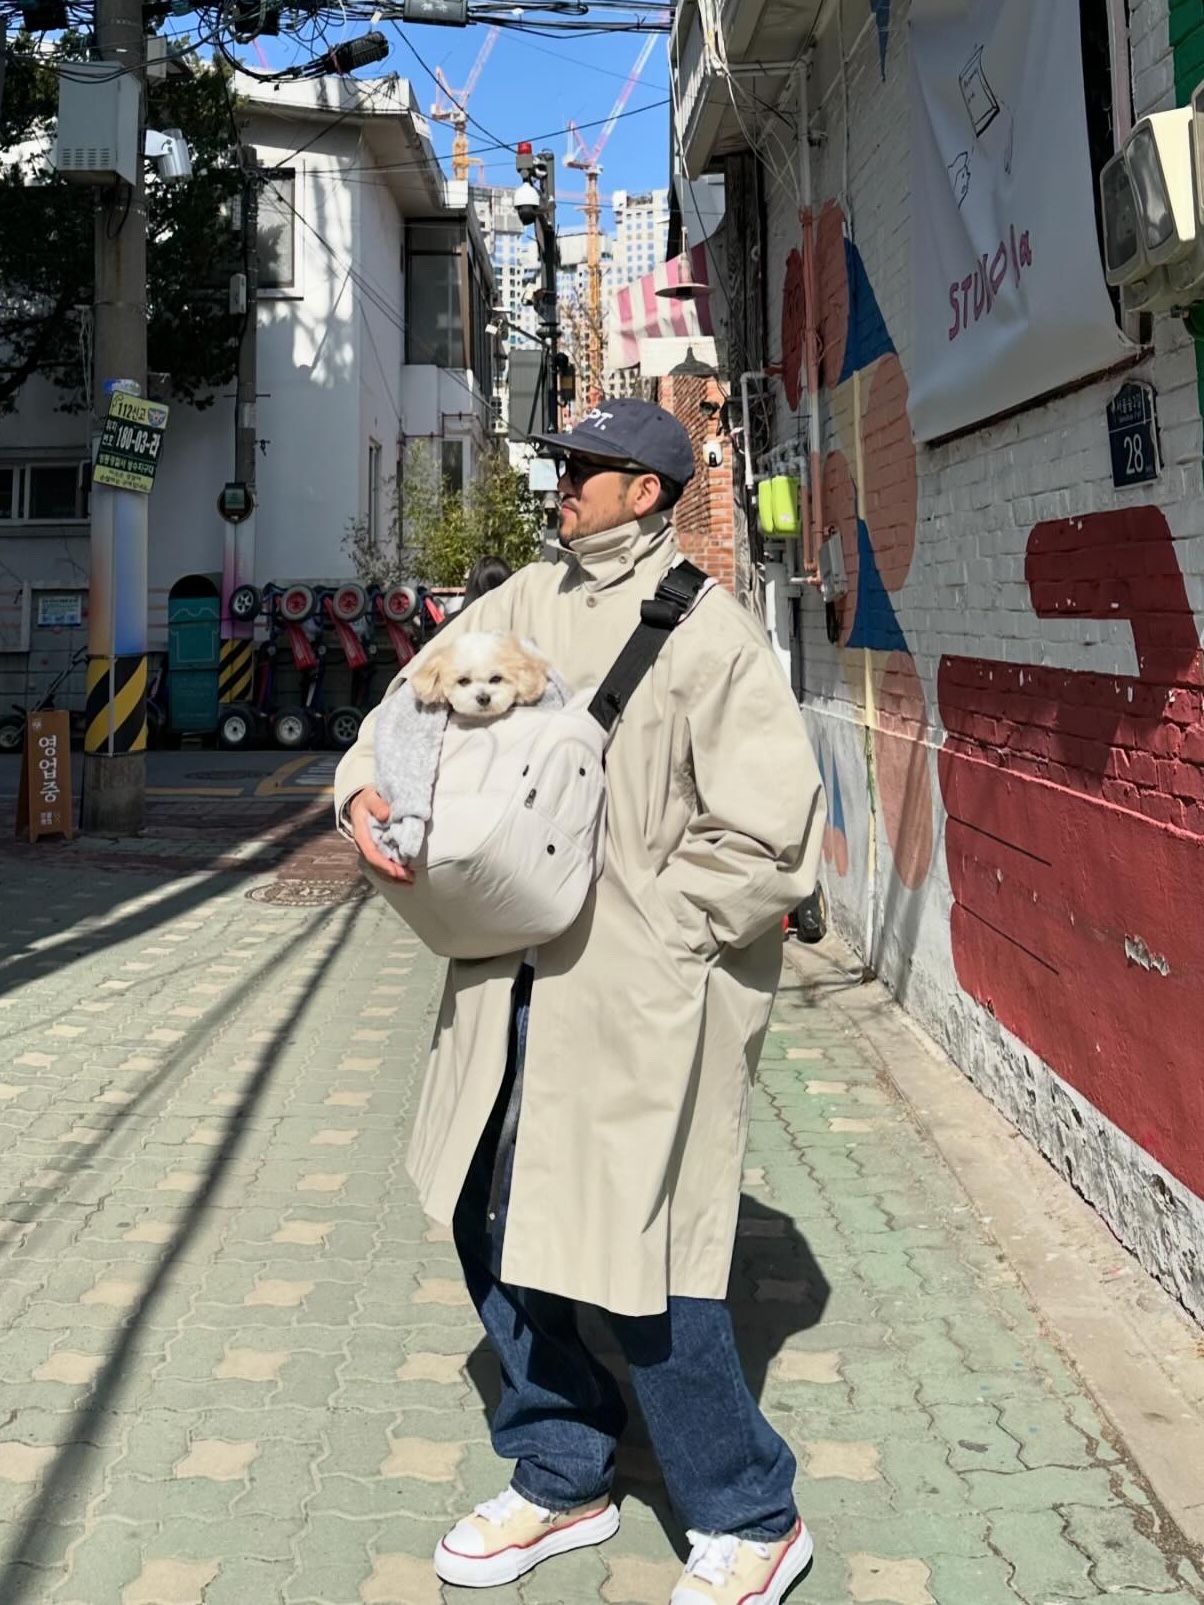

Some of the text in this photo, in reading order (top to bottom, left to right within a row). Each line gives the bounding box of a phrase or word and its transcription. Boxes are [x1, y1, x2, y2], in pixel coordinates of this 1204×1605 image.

[118, 402, 147, 421] 112신고
[1123, 433, 1144, 475] 28
[38, 735, 60, 802] 영업중
